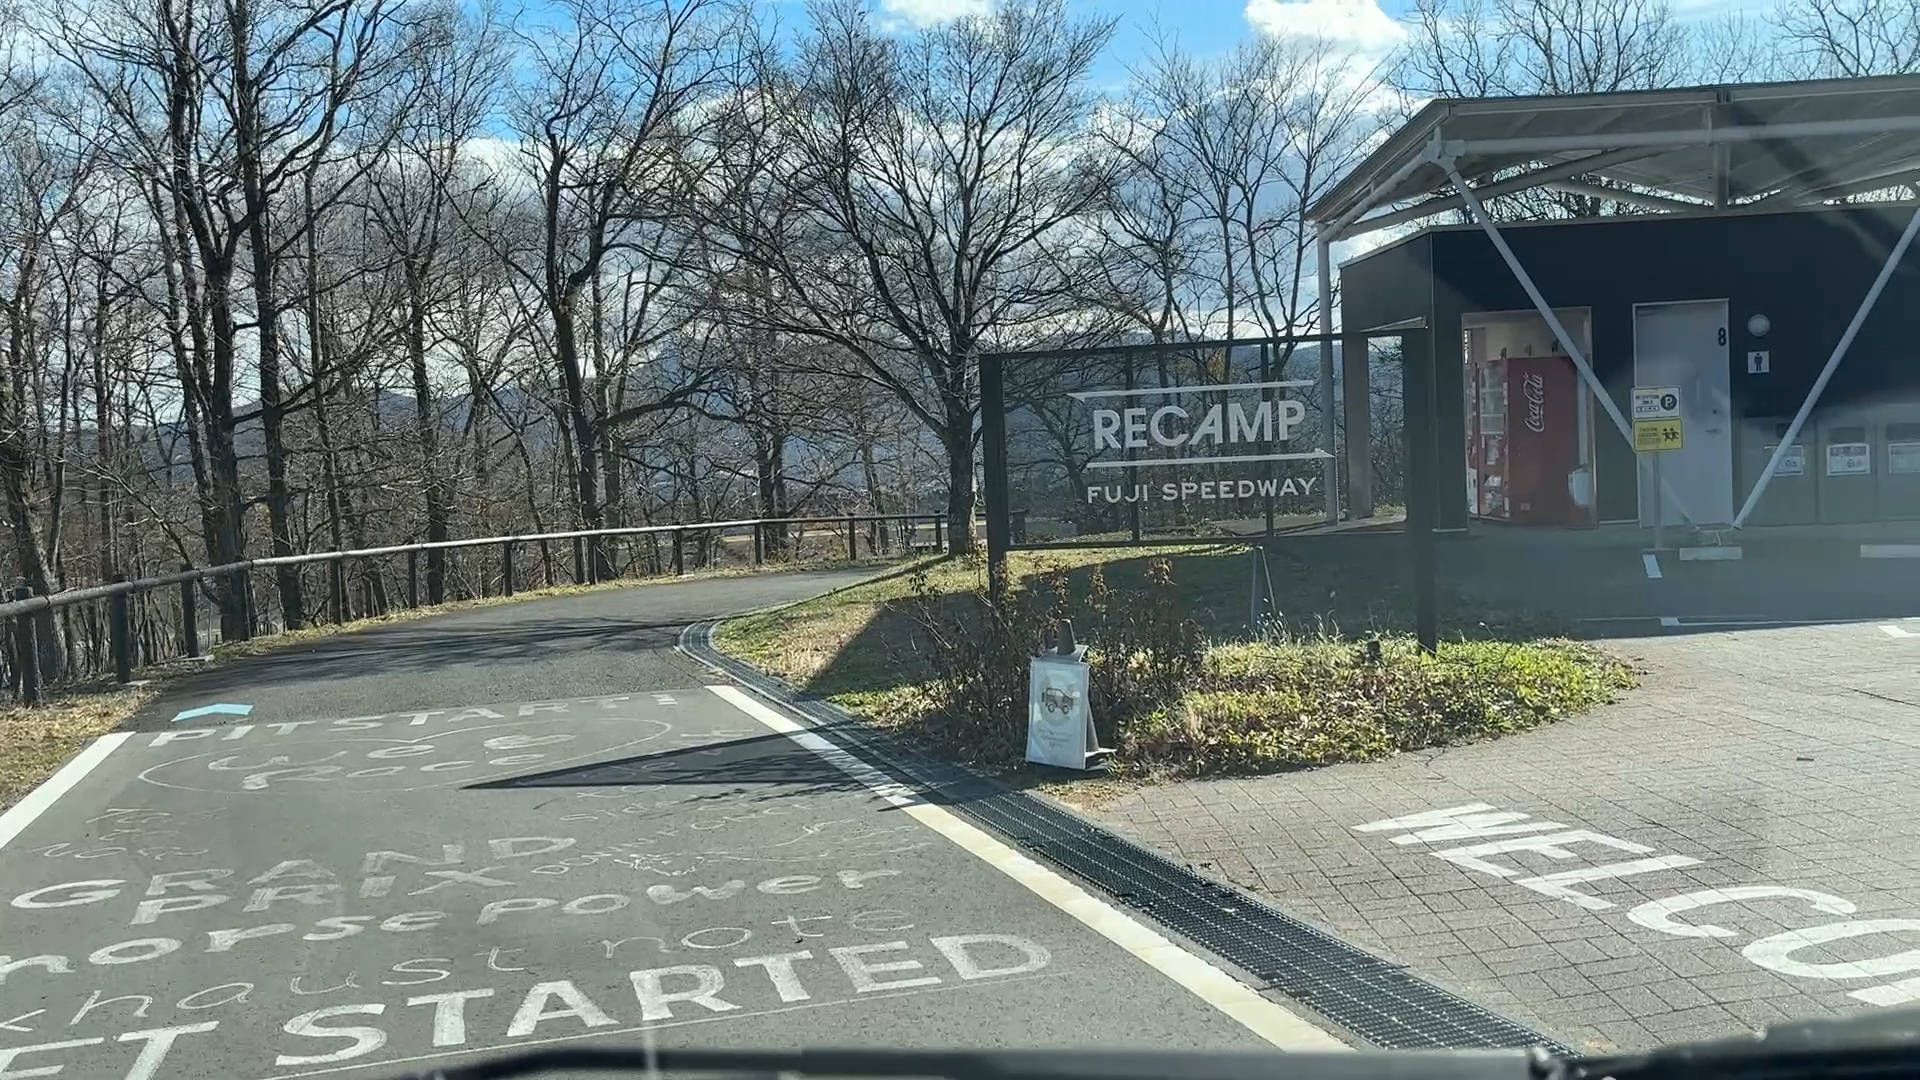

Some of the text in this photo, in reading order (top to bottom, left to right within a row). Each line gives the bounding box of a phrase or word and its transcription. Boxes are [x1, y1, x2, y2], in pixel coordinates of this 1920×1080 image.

[1093, 400, 1306, 450] RECAMP
[1087, 476, 1317, 504] FUJI SPEEDWAY
[10, 836, 577, 909] GRAND
[129, 864, 517, 926] PRIX
[1350, 801, 1920, 1006] WELCO
[275, 932, 1052, 1067] STARTED
